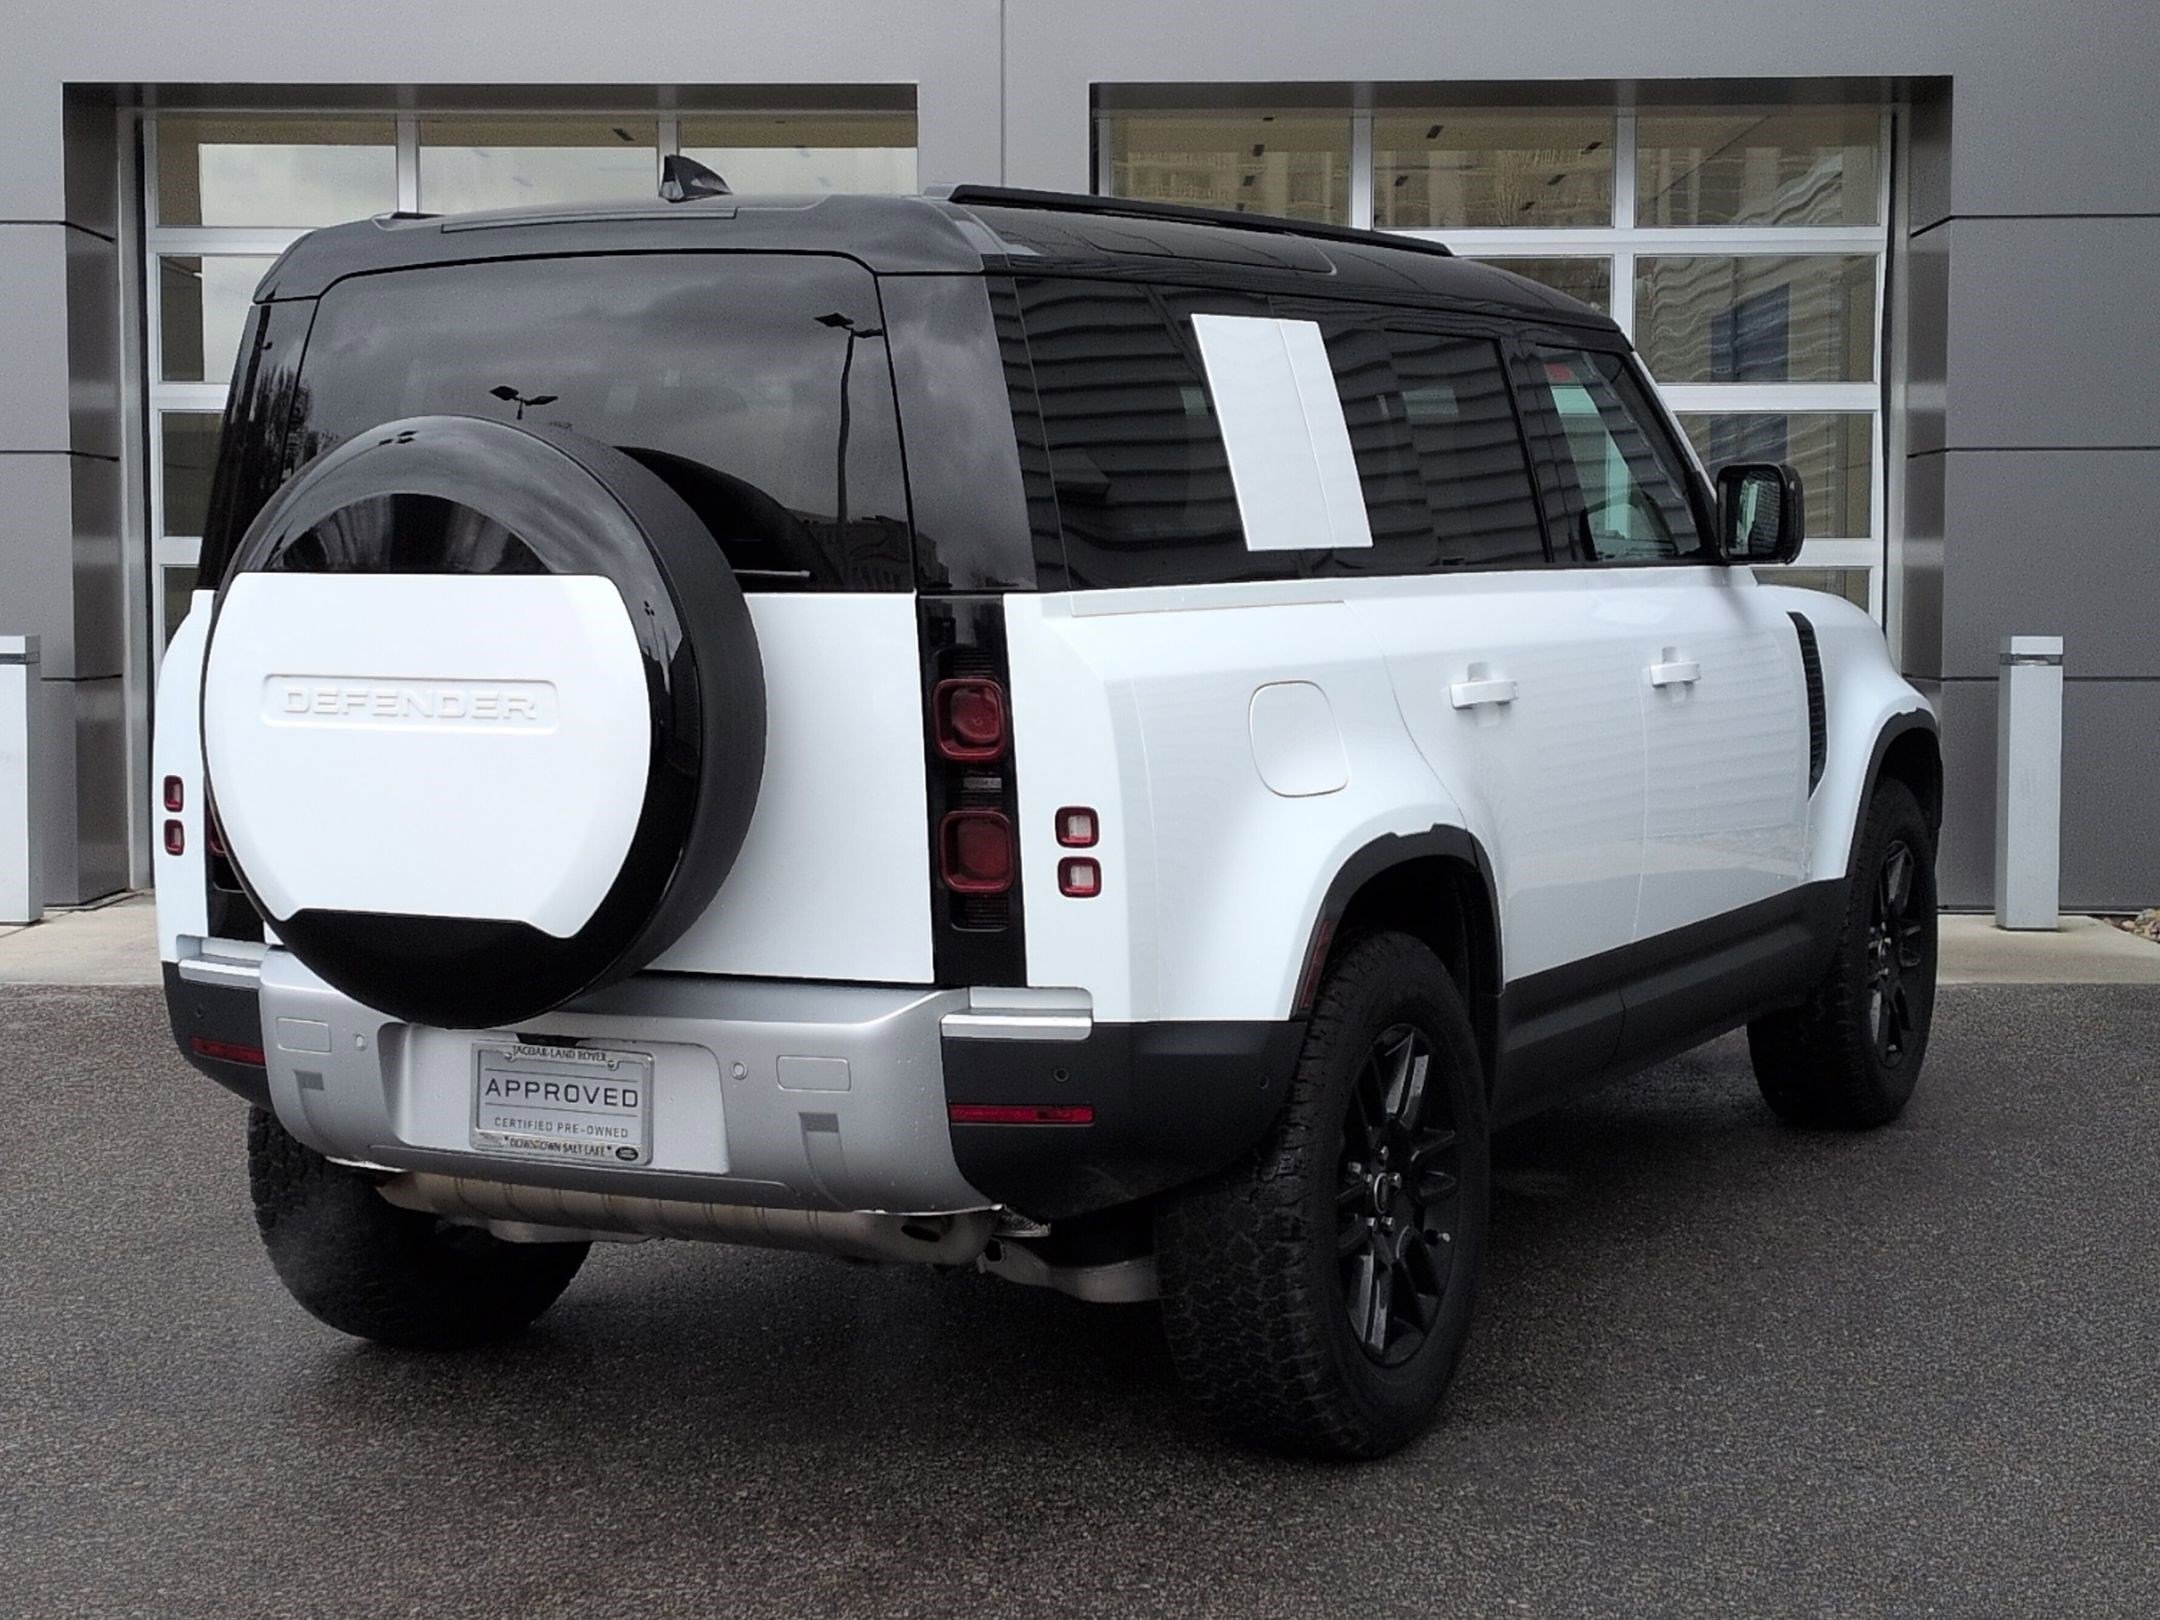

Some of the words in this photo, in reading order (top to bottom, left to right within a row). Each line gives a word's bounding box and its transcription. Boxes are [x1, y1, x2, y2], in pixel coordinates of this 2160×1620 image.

[284, 688, 536, 720] DEFENDER
[485, 1078, 638, 1108] APPROVED
[494, 1116, 553, 1132] CERTIFIED
[557, 1122, 629, 1138] PRE-OWNED
